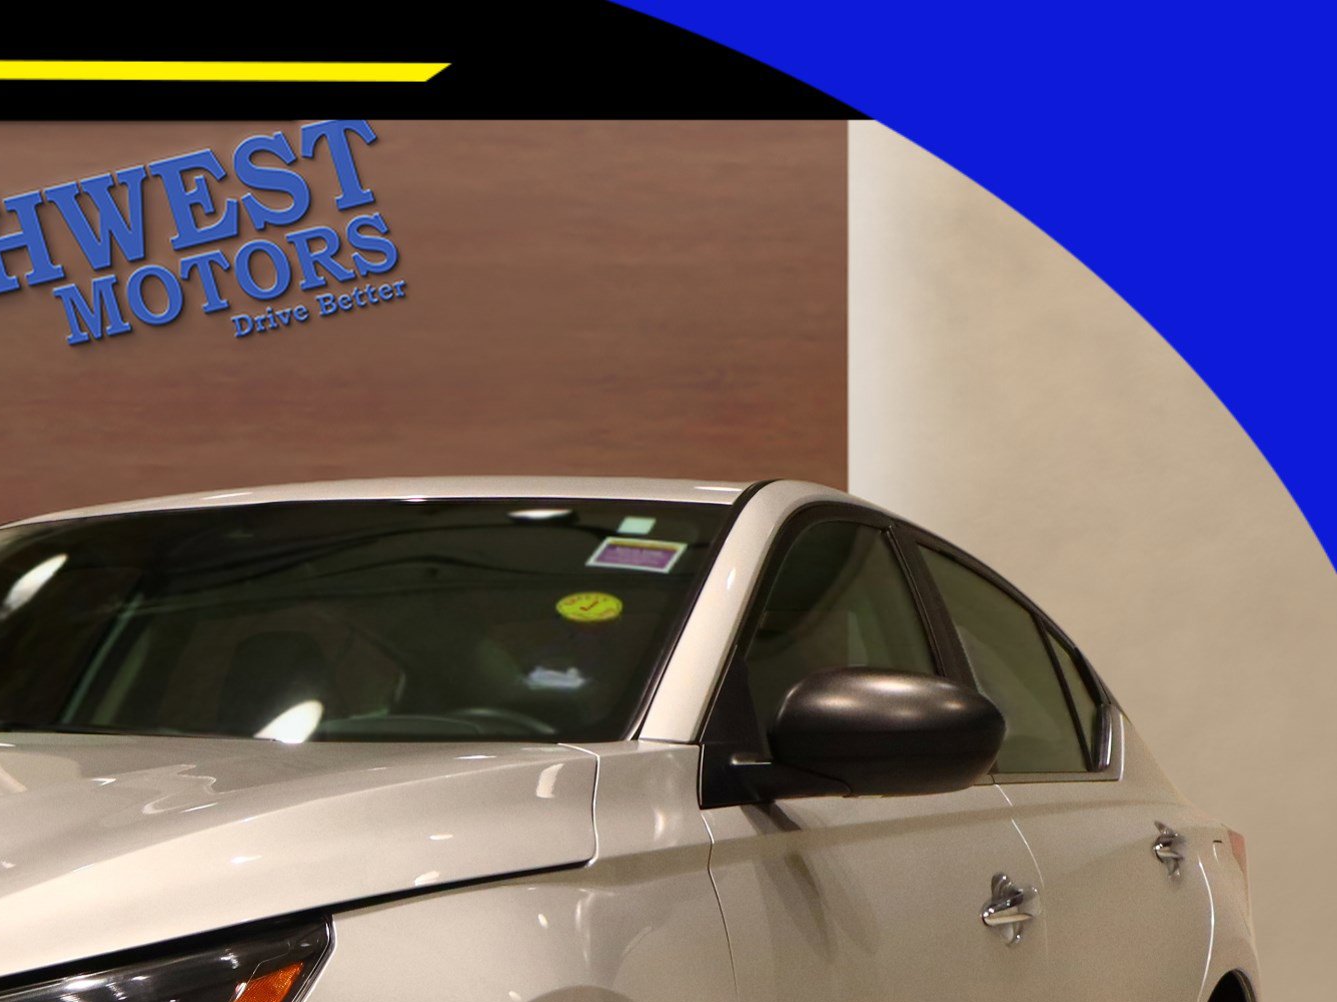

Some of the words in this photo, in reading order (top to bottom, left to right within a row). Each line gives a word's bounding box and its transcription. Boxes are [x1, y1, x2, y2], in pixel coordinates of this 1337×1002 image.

[53, 213, 398, 345] MOTORS
[231, 304, 310, 338] Drive
[316, 281, 407, 316] Better
